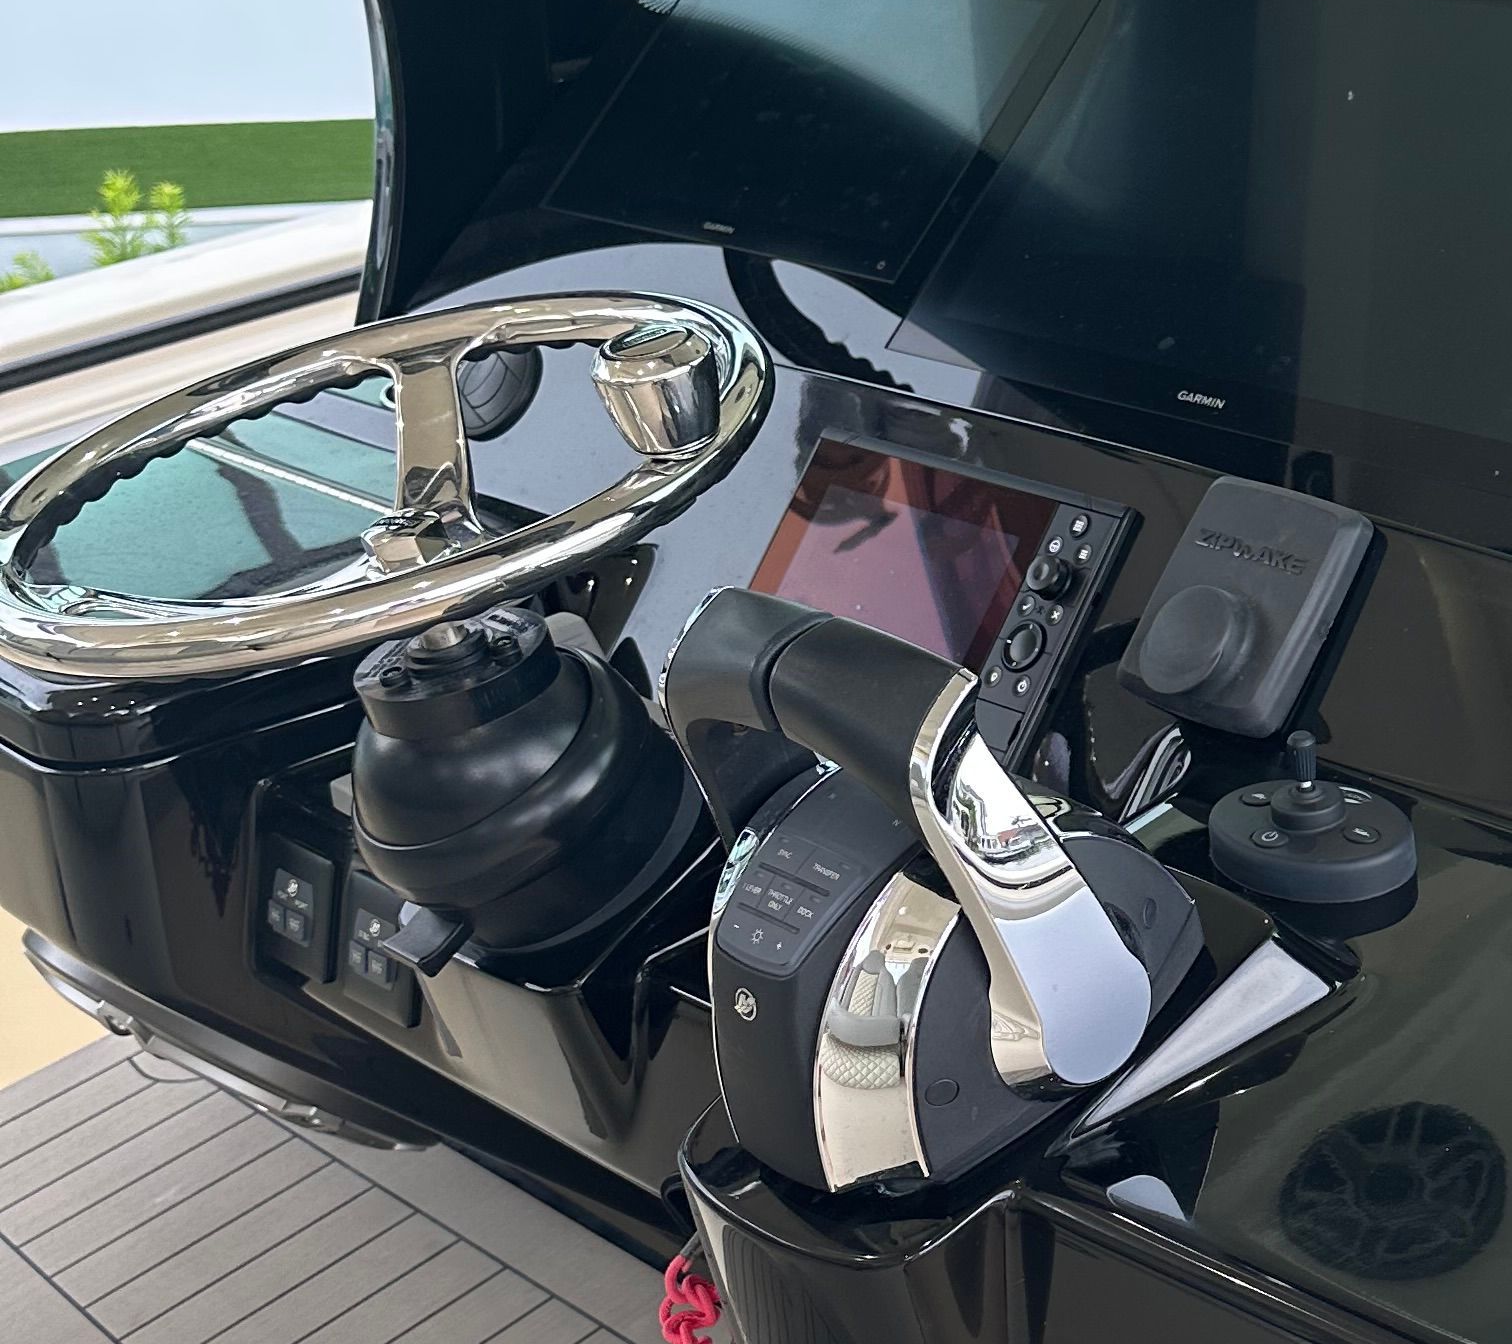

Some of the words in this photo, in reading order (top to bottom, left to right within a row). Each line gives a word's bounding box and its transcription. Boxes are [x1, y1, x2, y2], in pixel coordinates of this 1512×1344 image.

[1177, 390, 1226, 409] GARMIN
[1195, 527, 1309, 576] ZIPWAKE
[812, 862, 841, 881] TRANSFER
[767, 888, 794, 905] THROTTLE
[767, 900, 783, 911] ONLY
[797, 905, 814, 919] DOCK
